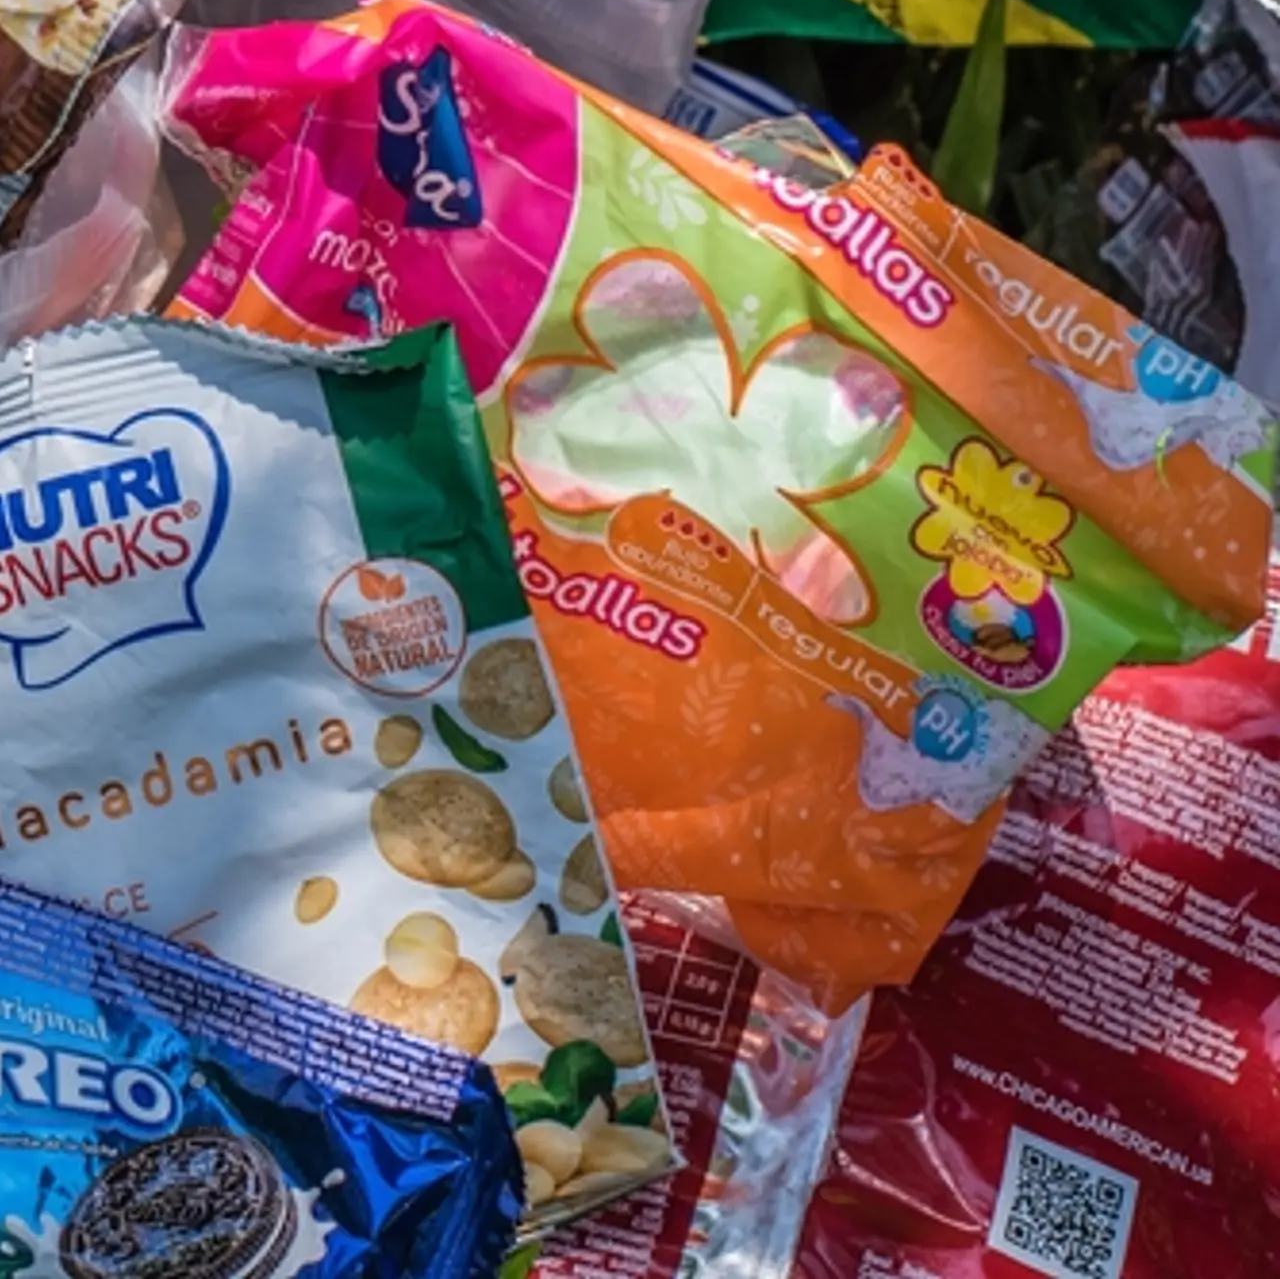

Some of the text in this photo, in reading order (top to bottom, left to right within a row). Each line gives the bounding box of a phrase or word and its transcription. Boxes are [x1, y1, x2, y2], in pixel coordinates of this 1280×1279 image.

[965, 249, 1125, 365] regular
[353, 638, 456, 678] NATURAL
[757, 601, 911, 712] regular
[919, 701, 973, 755] pH
